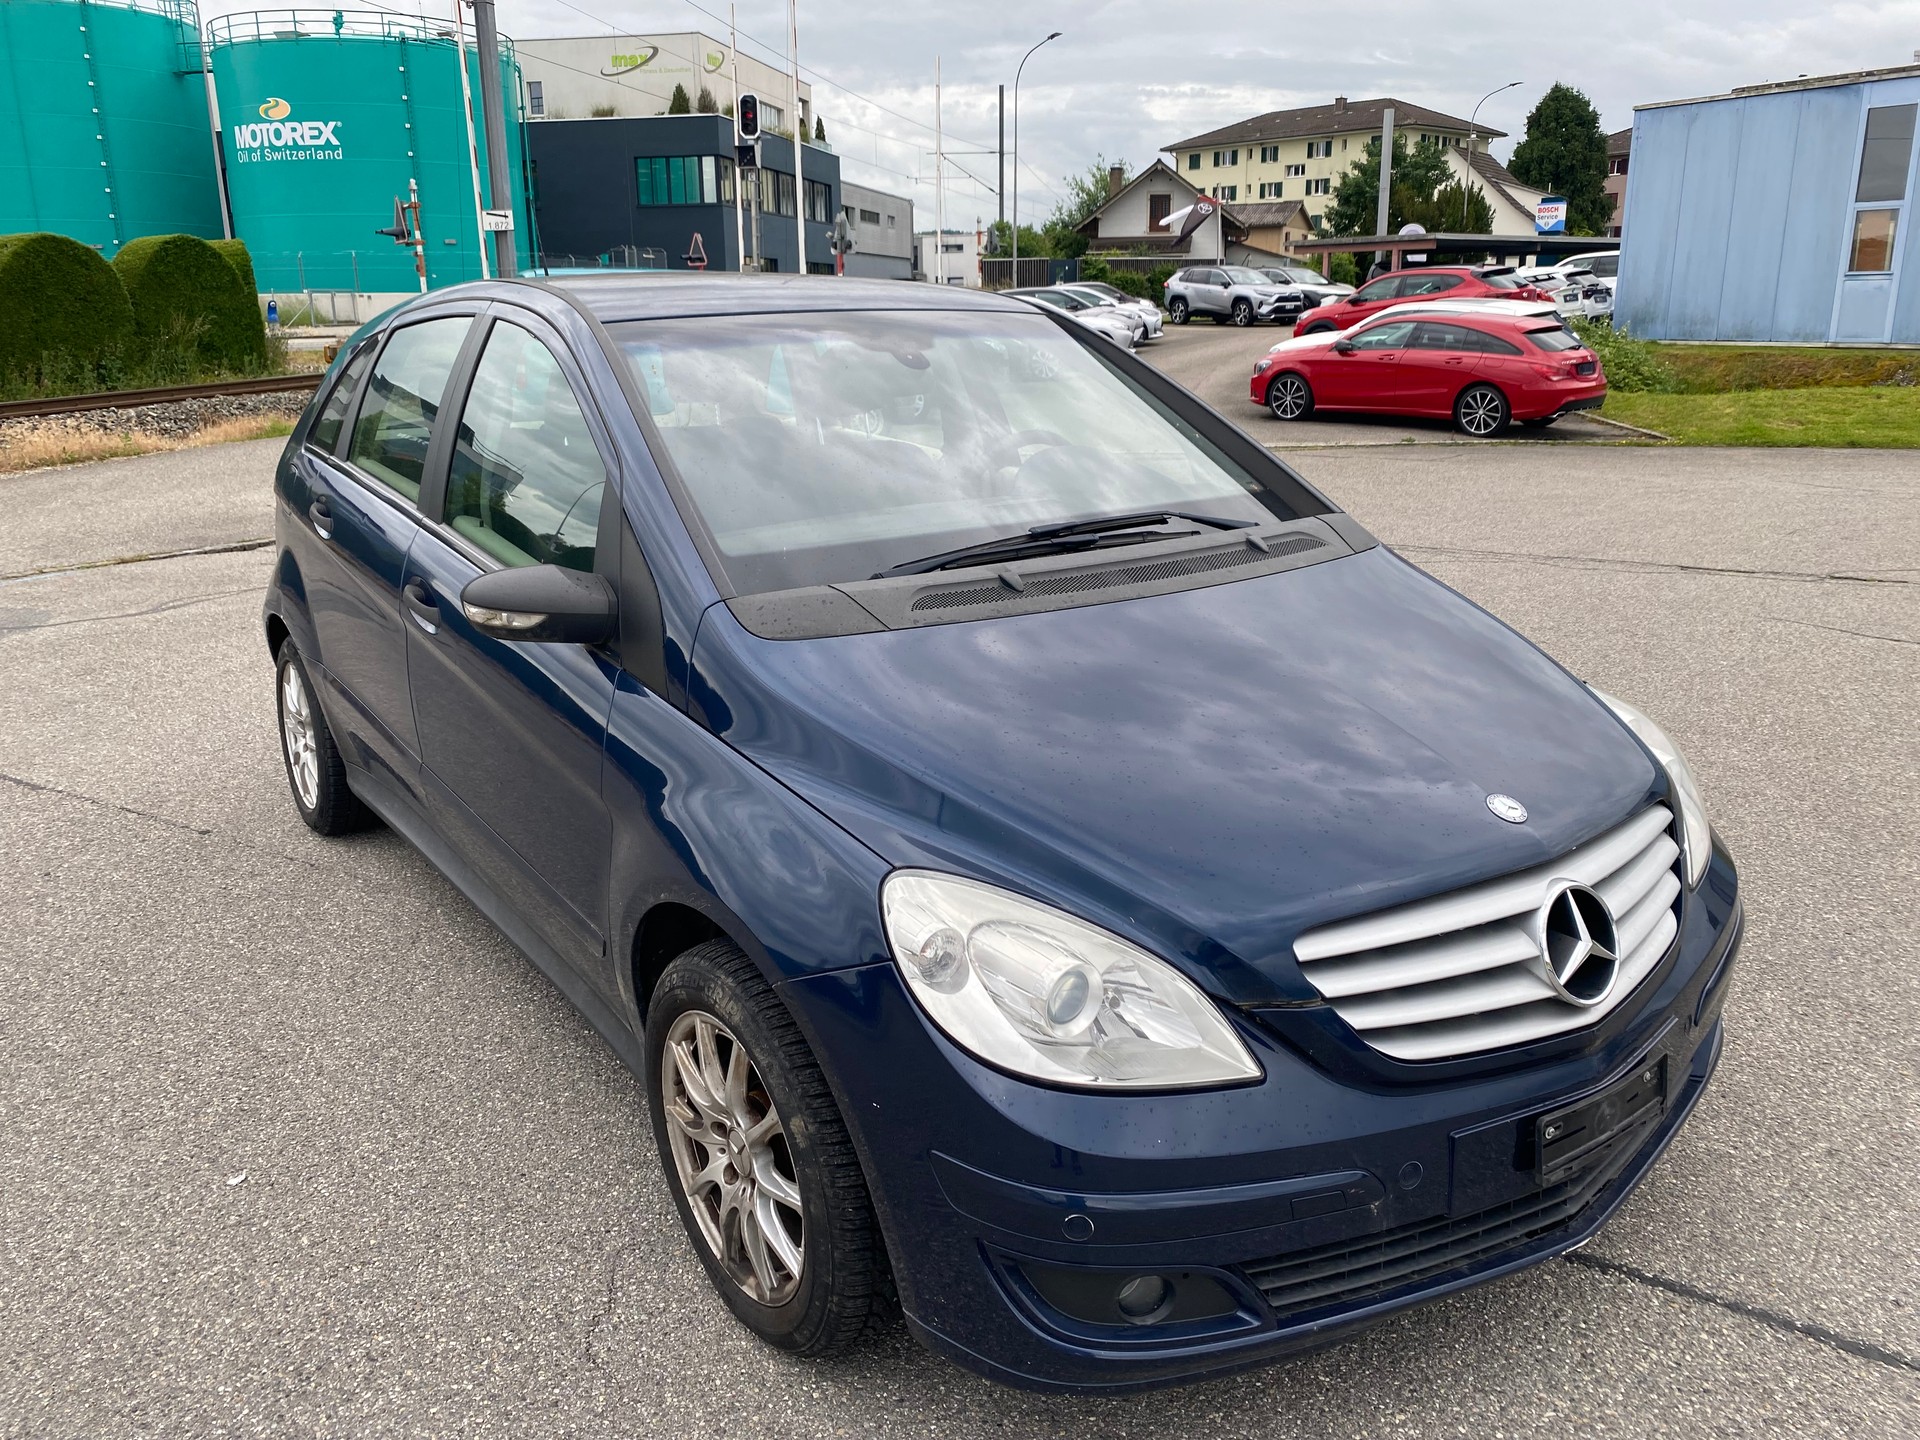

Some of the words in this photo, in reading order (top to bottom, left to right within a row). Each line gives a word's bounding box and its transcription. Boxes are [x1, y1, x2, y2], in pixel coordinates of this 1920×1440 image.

[237, 151, 249, 164] Oil
[252, 149, 261, 162] of
[265, 147, 343, 162] Switzerland
